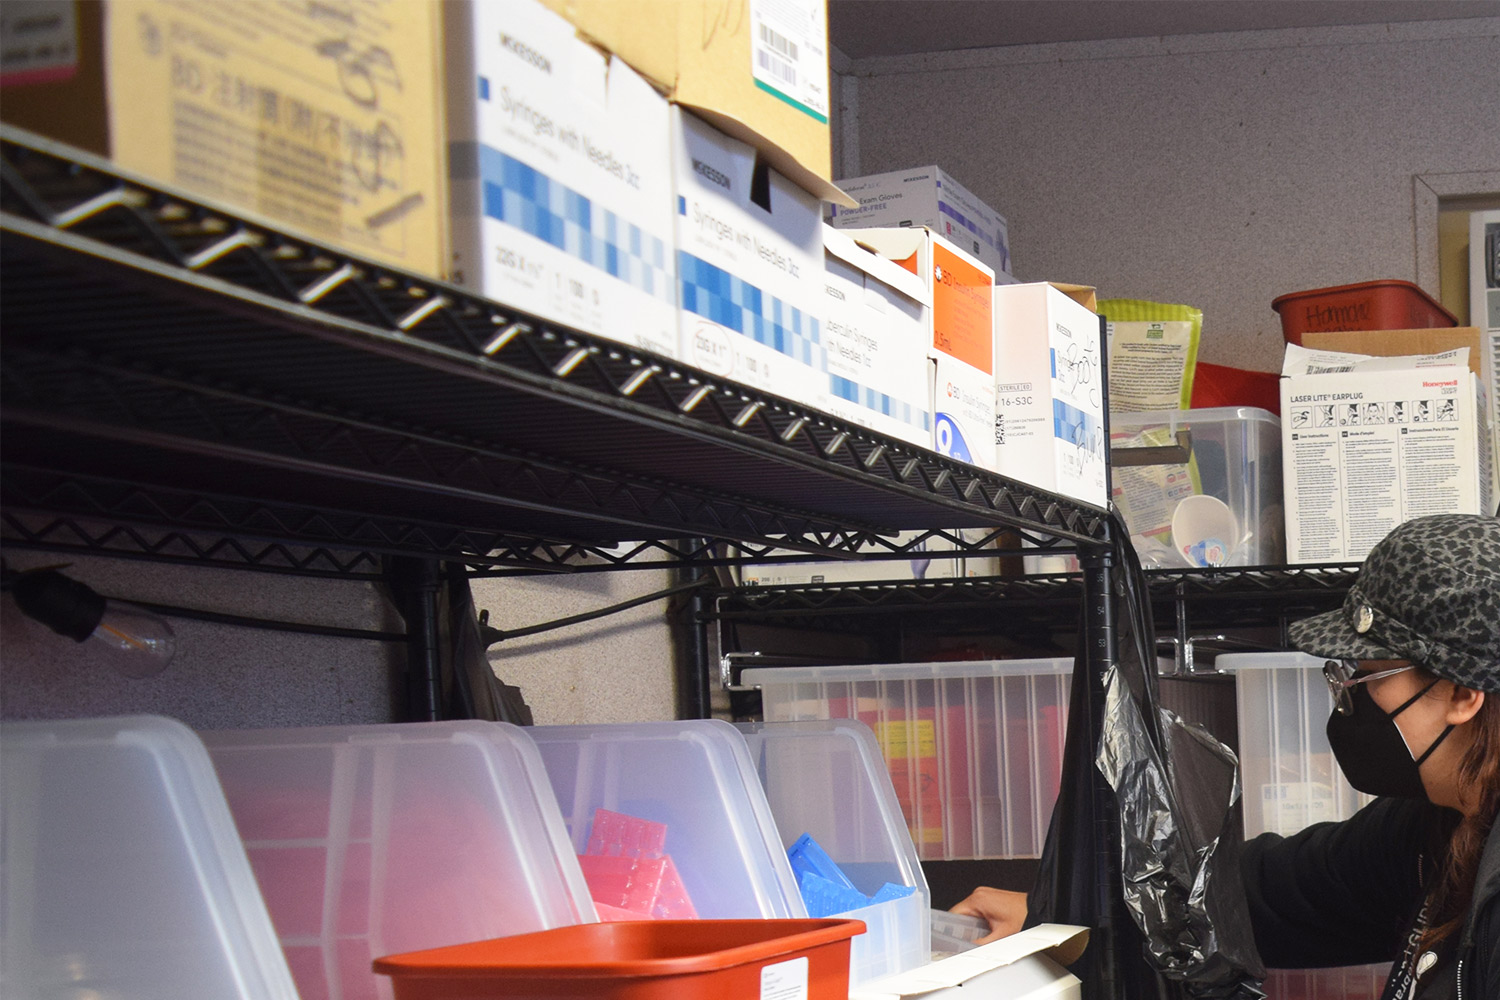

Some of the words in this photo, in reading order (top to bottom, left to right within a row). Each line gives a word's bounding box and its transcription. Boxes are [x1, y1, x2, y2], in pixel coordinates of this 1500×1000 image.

[501, 85, 554, 137] Syringes
[582, 134, 624, 180] Needles
[859, 194, 877, 204] Exam
[878, 192, 903, 203] Gloves
[840, 203, 887, 216] POWDER-FREE
[694, 202, 733, 242] Syringes
[753, 234, 786, 272] Needles
[1422, 380, 1458, 389] Honeywell
[1001, 397, 1033, 406] 16-S3C
[1290, 394, 1314, 403] LASER
[1332, 392, 1363, 401] EARPLUG
